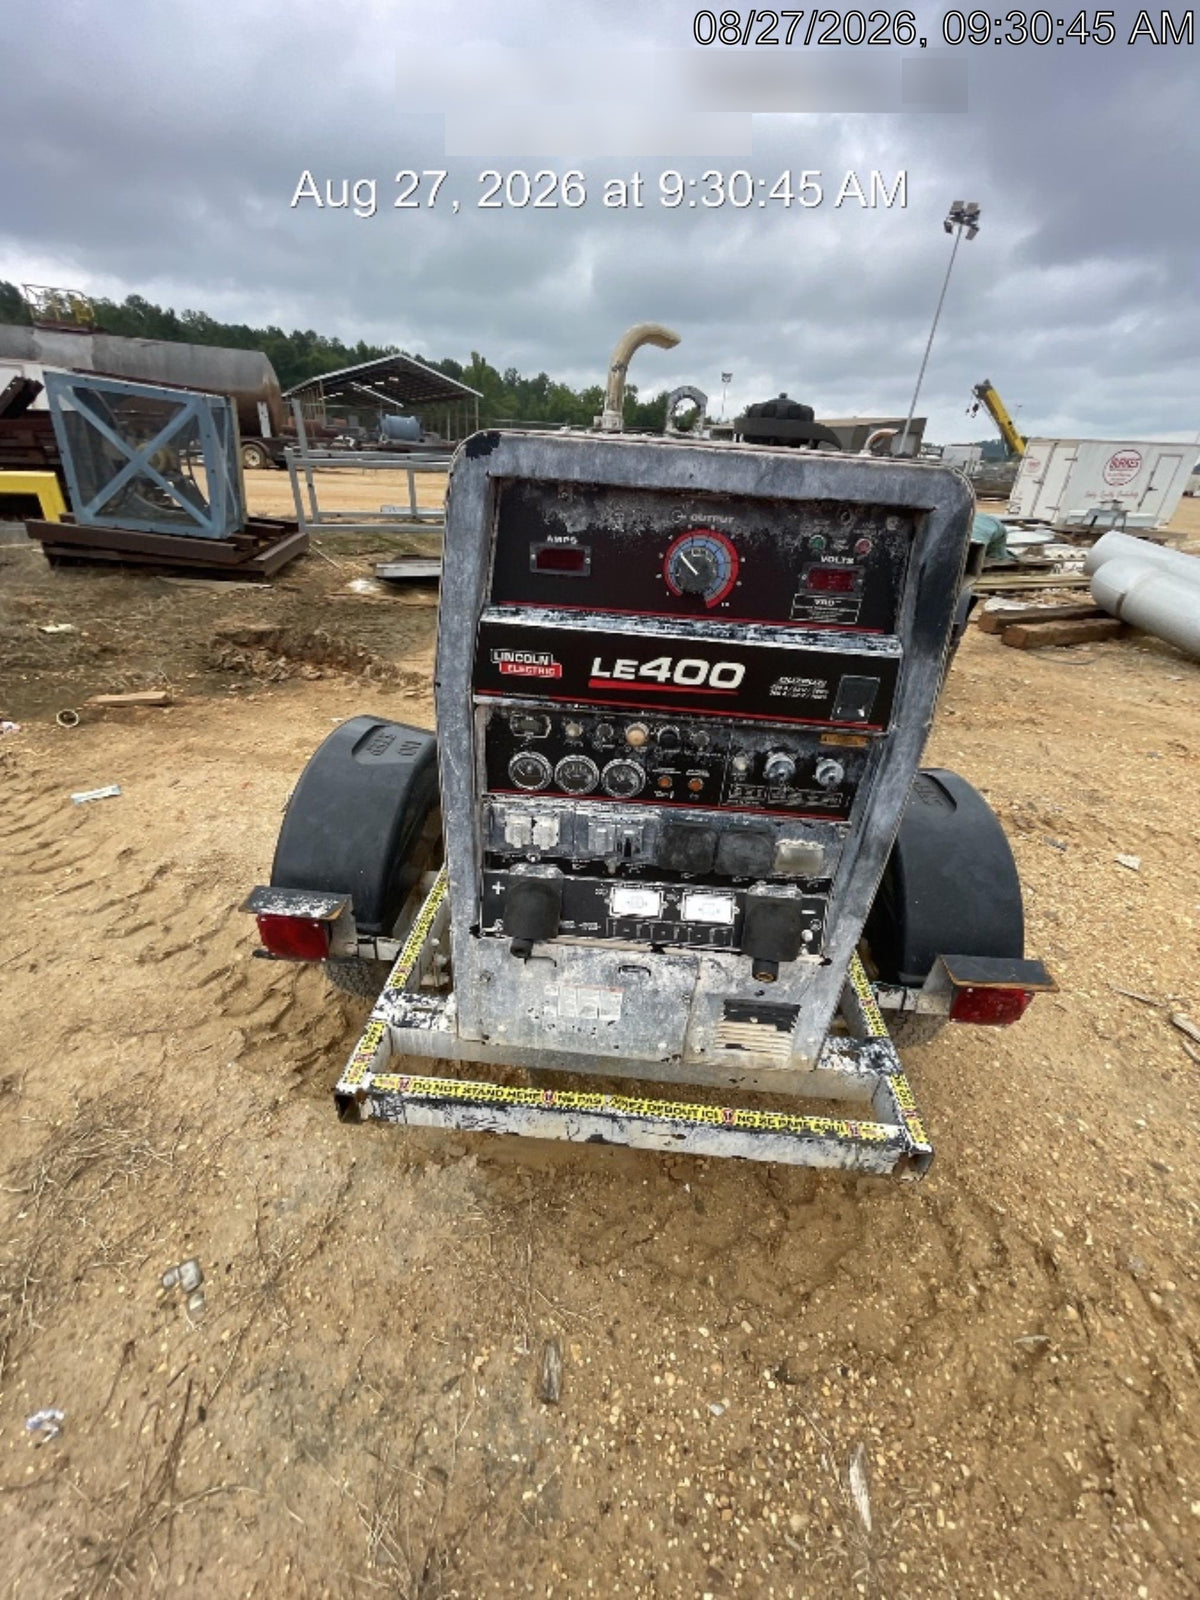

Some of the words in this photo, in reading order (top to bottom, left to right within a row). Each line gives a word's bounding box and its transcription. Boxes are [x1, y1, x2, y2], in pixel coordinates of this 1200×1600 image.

[690, 513, 736, 523] OUTPUT
[546, 534, 578, 544] AMPS
[820, 555, 855, 565] VOLTS
[493, 651, 550, 666] LINCOLN
[507, 663, 557, 676] ELECTRIC
[590, 656, 746, 689] LE400
[413, 1081, 431, 1091] DO
[433, 1083, 460, 1094] NOT
[462, 1086, 504, 1098] STAND
[507, 1089, 541, 1101] HERE
[577, 1095, 602, 1105] PAS
[646, 1103, 698, 1117] DEBOUT
[701, 1110, 719, 1119] ICI
[736, 1113, 756, 1124] NO
[778, 1118, 811, 1130] PARE
